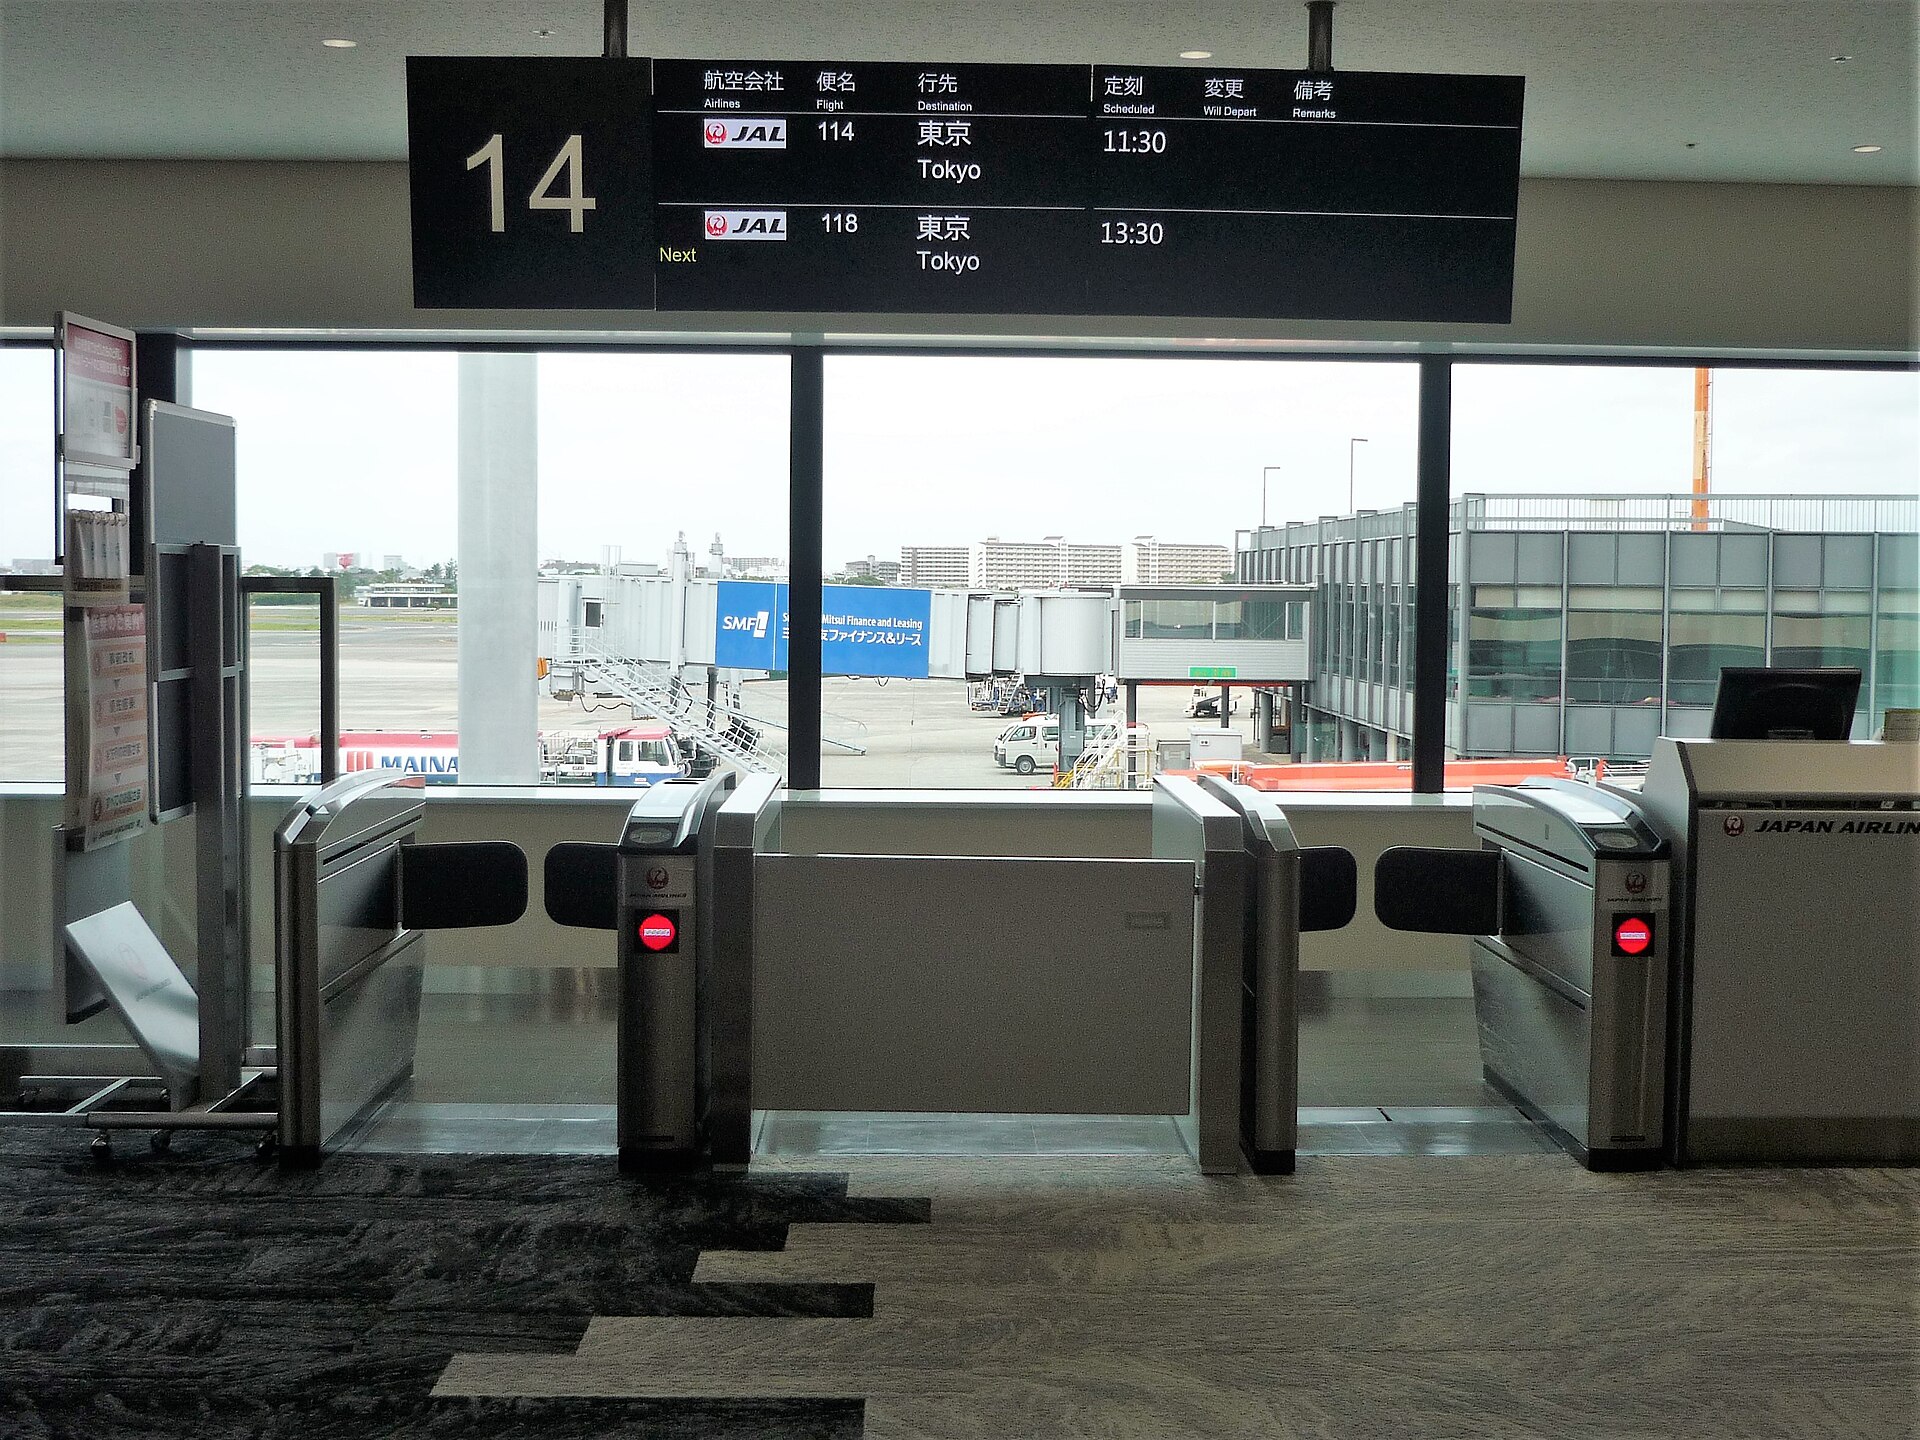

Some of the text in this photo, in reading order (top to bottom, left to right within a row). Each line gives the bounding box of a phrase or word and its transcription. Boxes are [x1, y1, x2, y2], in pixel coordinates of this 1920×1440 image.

[703, 69, 785, 92] 航空会社
[816, 71, 856, 93] 便名
[917, 72, 958, 94] 行先
[1104, 75, 1144, 96] 定刻
[1204, 77, 1245, 99] 変更
[1293, 79, 1334, 101] 備考
[703, 98, 741, 109] Airlines
[816, 99, 844, 112] Flight
[917, 100, 973, 112] Destination
[1103, 103, 1155, 115] Scheduled
[1203, 105, 1257, 118] Will Depart
[1292, 107, 1336, 119] Remarks
[731, 126, 785, 141] JAL
[818, 121, 855, 142] 114
[917, 119, 972, 147] 東京
[1103, 130, 1167, 154] 11:30
[917, 158, 981, 184] Tokyo
[466, 133, 597, 233] 14
[732, 218, 785, 233] JAL
[821, 213, 858, 233] 118
[916, 214, 971, 242] 東京
[1101, 221, 1164, 245] 13:30
[659, 246, 697, 263] Next
[916, 250, 980, 276] Tokyo
[821, 614, 923, 631] Mitsui Finance and Leasing
[381, 755, 458, 773] MAINA
[1754, 820, 1834, 833] JAPAN
